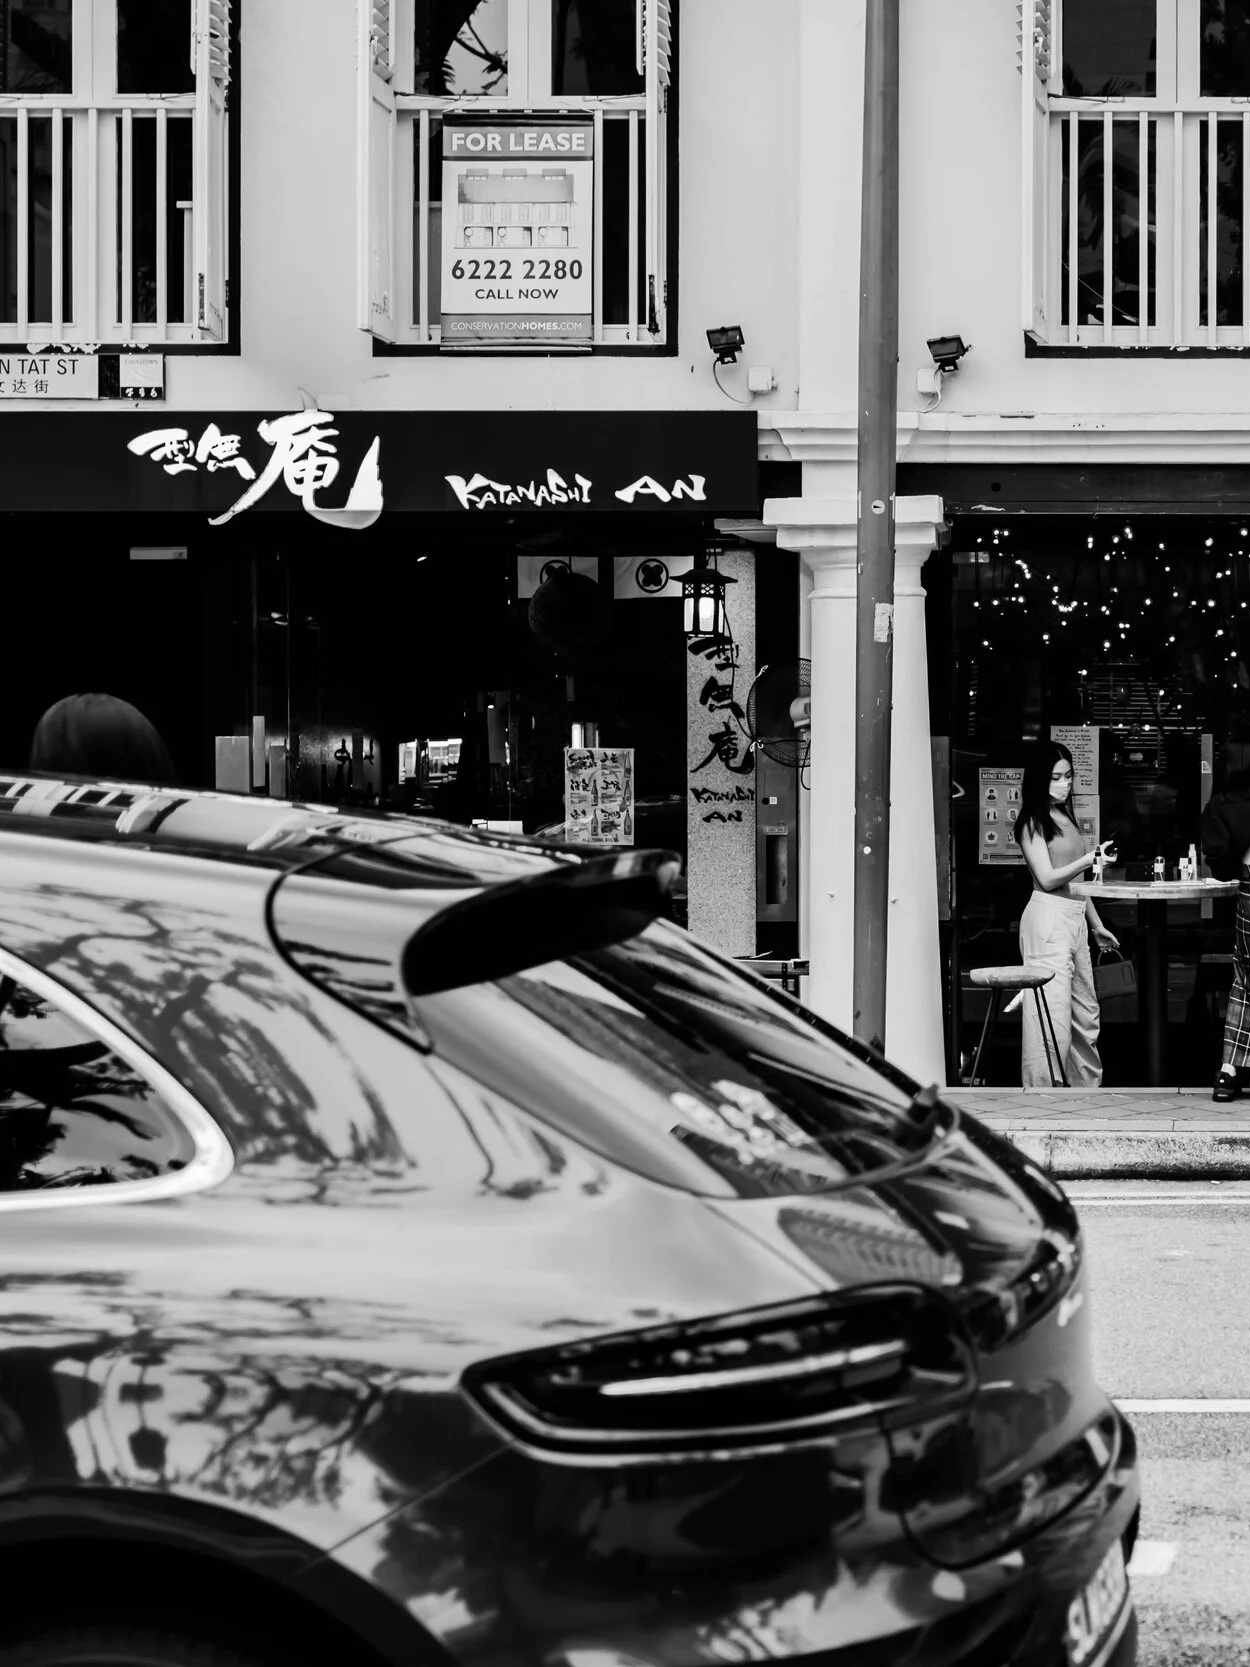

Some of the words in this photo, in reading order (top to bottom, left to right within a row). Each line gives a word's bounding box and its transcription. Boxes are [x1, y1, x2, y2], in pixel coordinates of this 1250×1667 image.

[452, 132, 502, 152] FOR
[509, 132, 586, 152] LEASE
[451, 259, 513, 280] 6222
[522, 259, 583, 280] 2280
[475, 288, 514, 300] CALL
[518, 288, 559, 300] NOW
[450, 321, 582, 331] CONSERVATIONHOMES.COM
[17, 358, 50, 375] TAT
[57, 358, 79, 375] ST
[444, 468, 592, 510] KATANASHI
[614, 474, 707, 503] AN
[702, 810, 743, 823] AN
